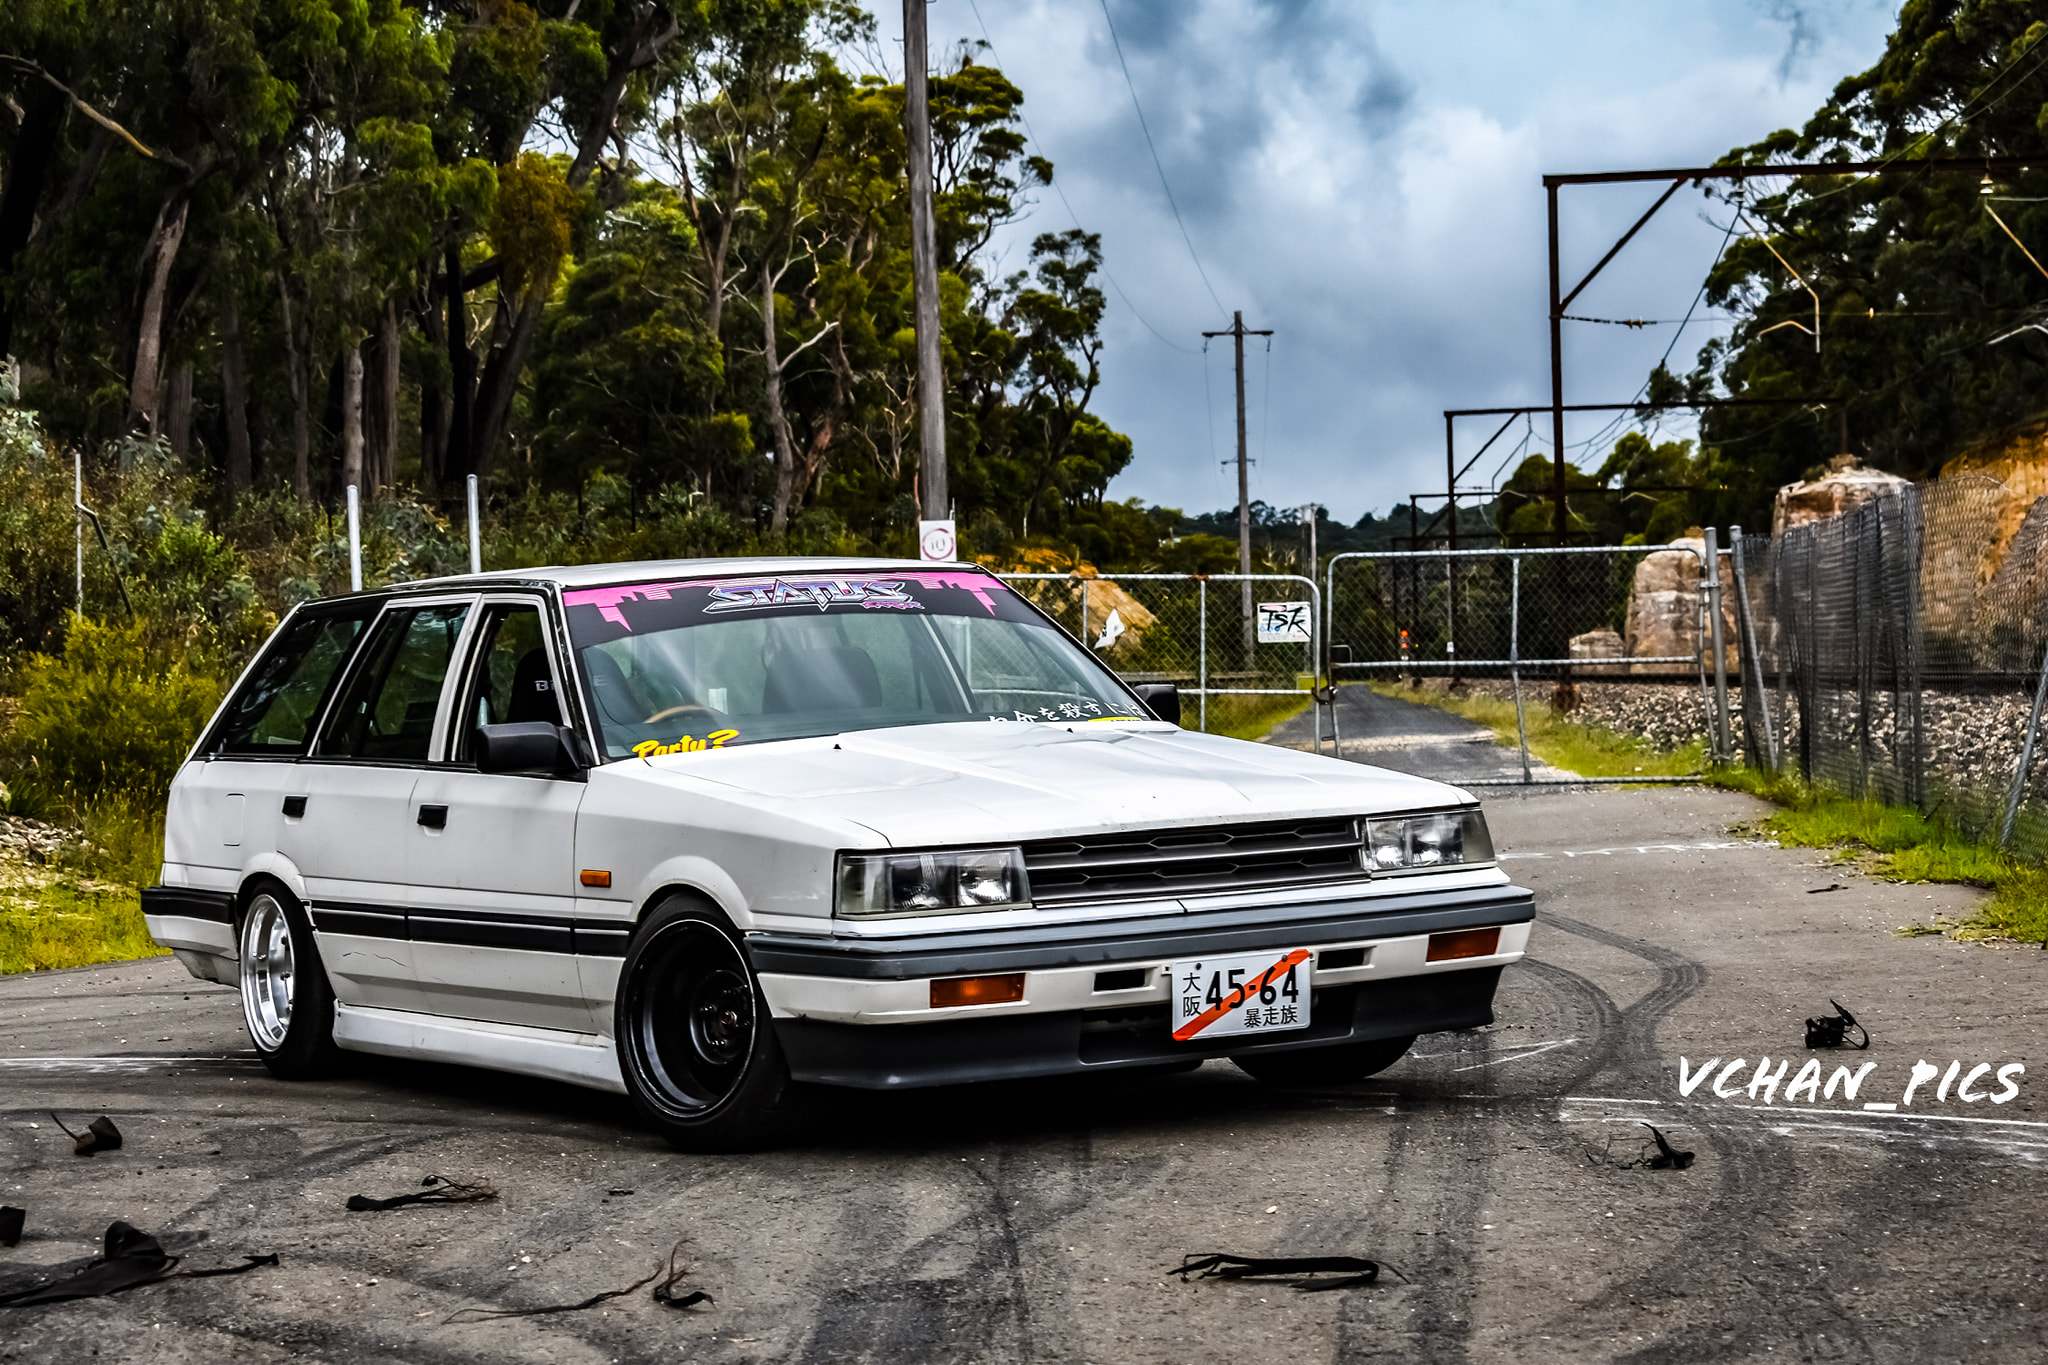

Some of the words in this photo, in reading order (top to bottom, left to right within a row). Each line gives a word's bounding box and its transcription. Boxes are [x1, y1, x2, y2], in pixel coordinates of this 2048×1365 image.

[702, 579, 913, 612] STATUS
[1183, 972, 1201, 1017] 大阪
[1206, 964, 1298, 1011] 45-64
[1244, 1004, 1298, 1028] 暴走族
